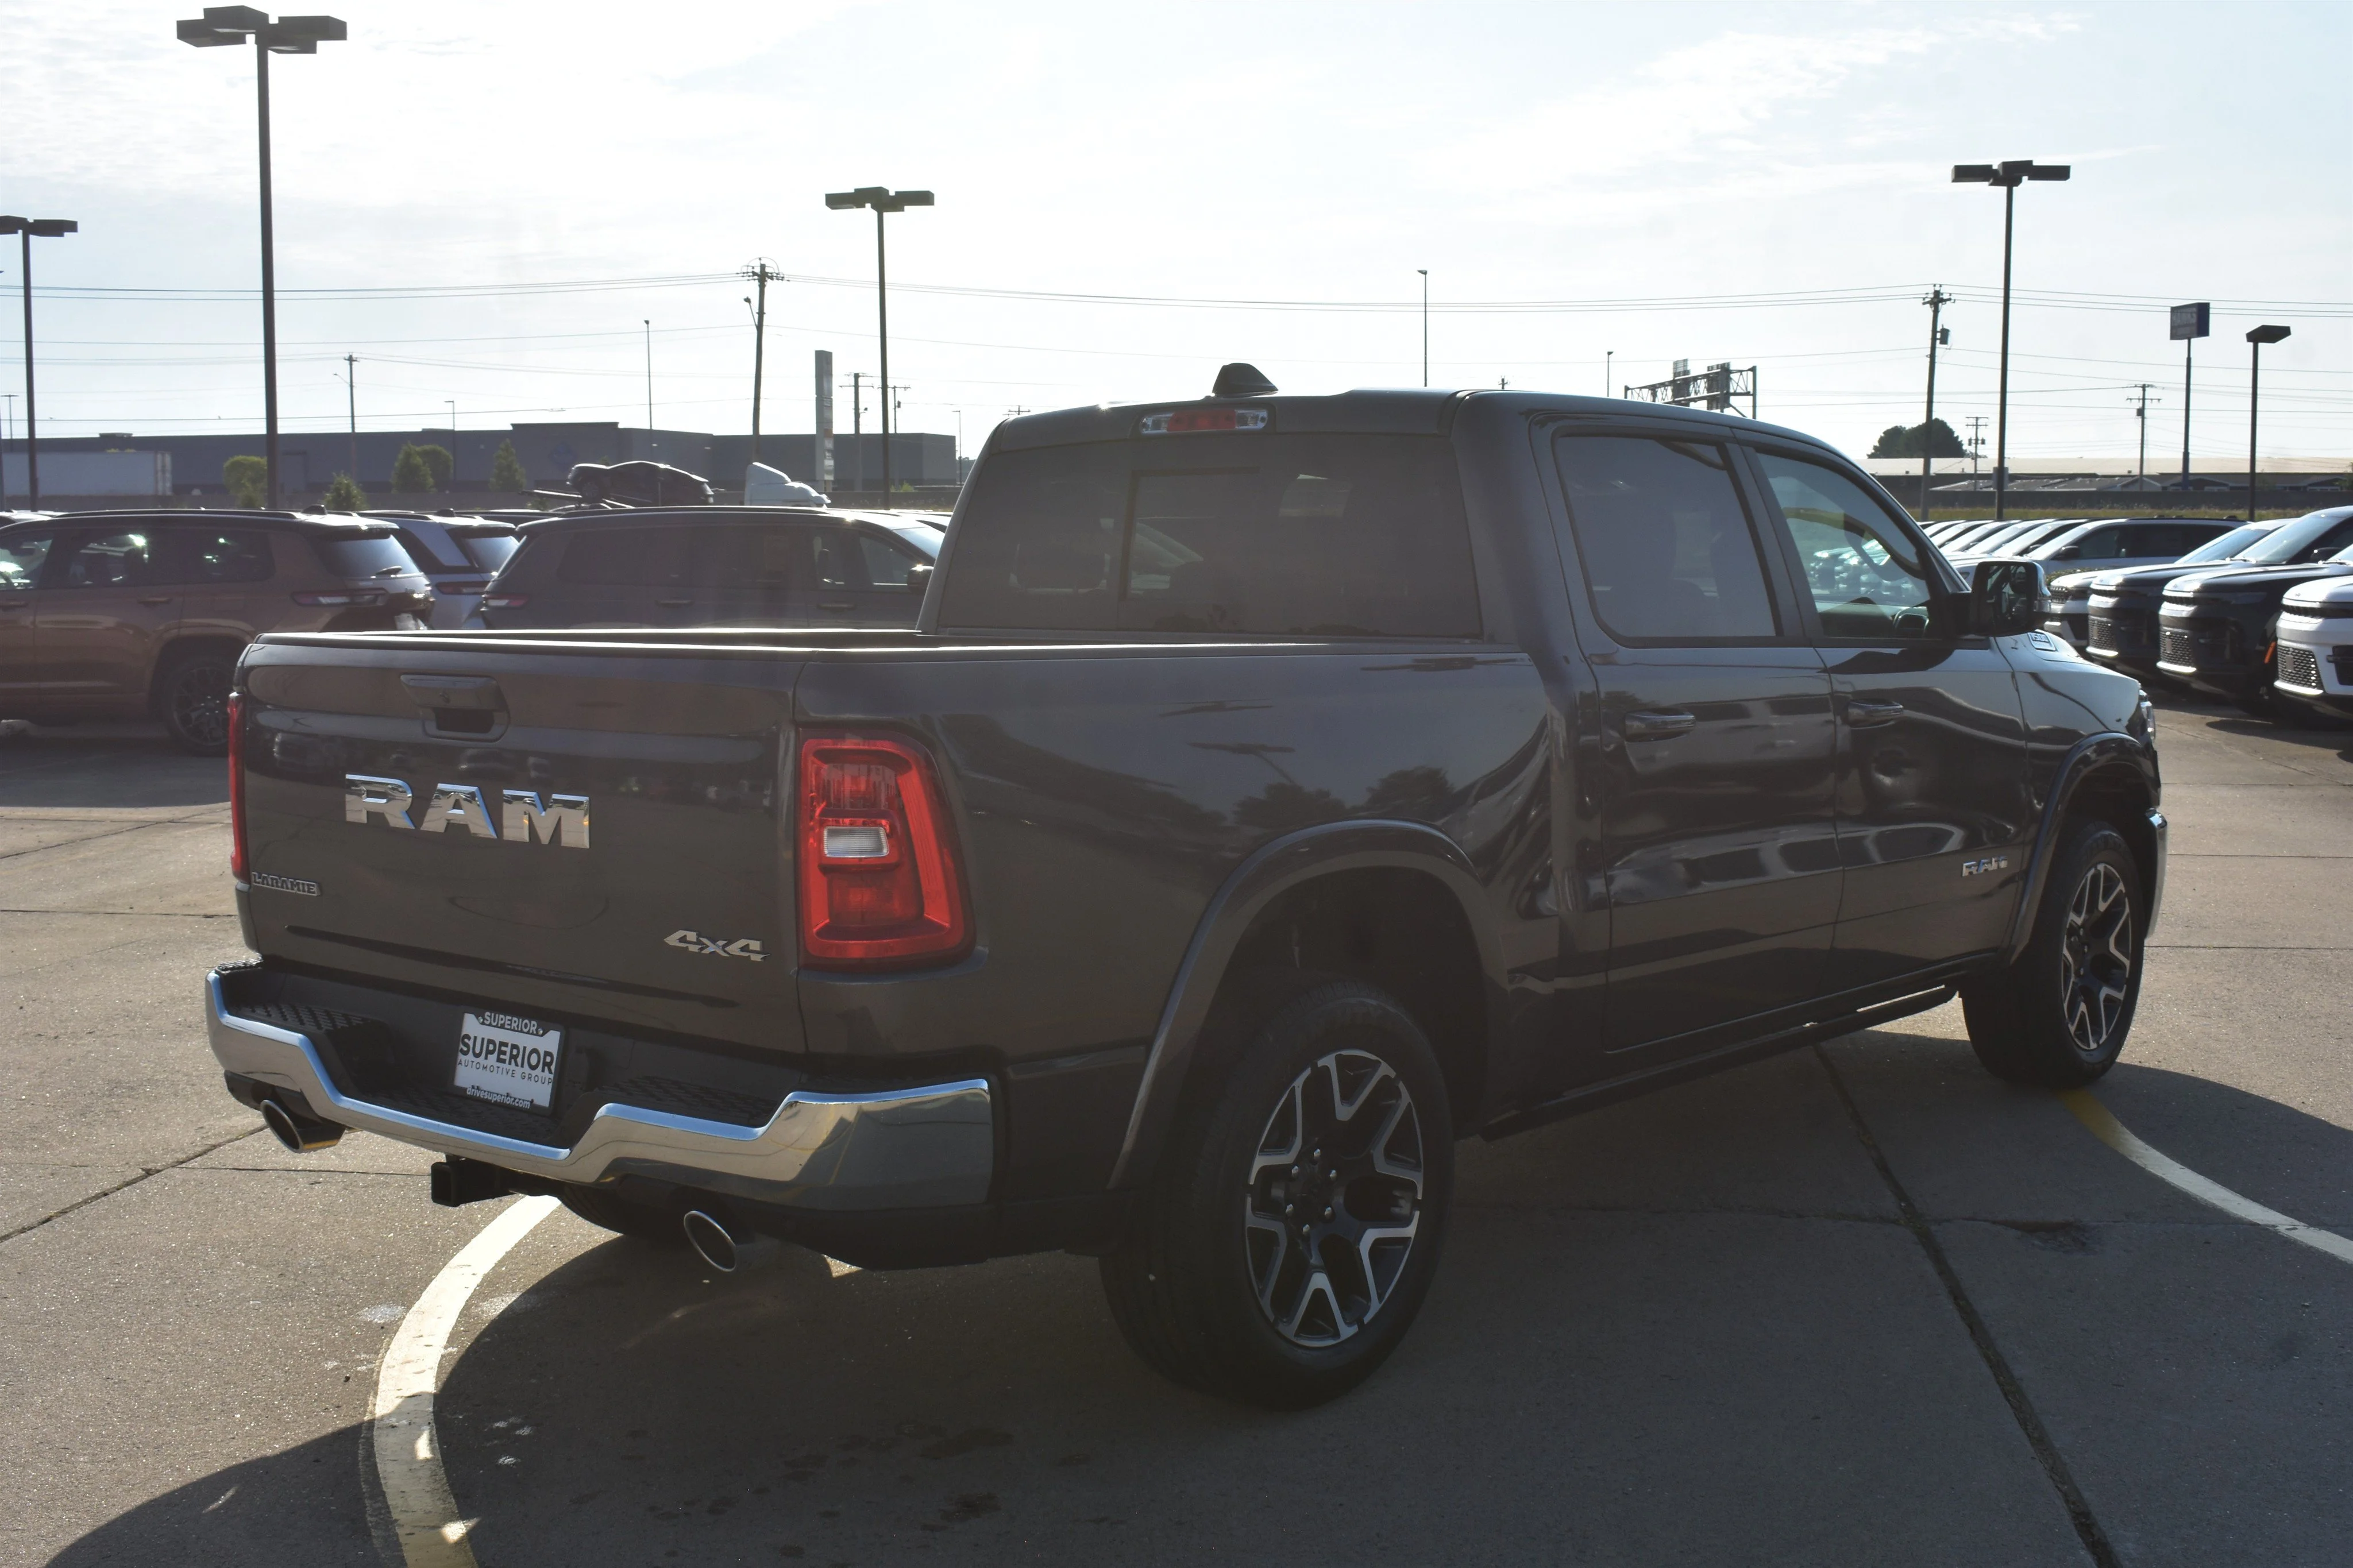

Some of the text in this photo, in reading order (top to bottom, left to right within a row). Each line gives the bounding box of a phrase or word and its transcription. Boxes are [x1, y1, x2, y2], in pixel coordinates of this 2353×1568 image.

[345, 774, 590, 849] RAM
[252, 872, 321, 896] LARAMIE
[484, 1012, 538, 1034] SUPERIOR
[459, 1033, 554, 1075] SUPERIOR
[458, 1060, 553, 1086] AUTOMOTIVE GROUP
[466, 1085, 530, 1109] drivesuperior.com
